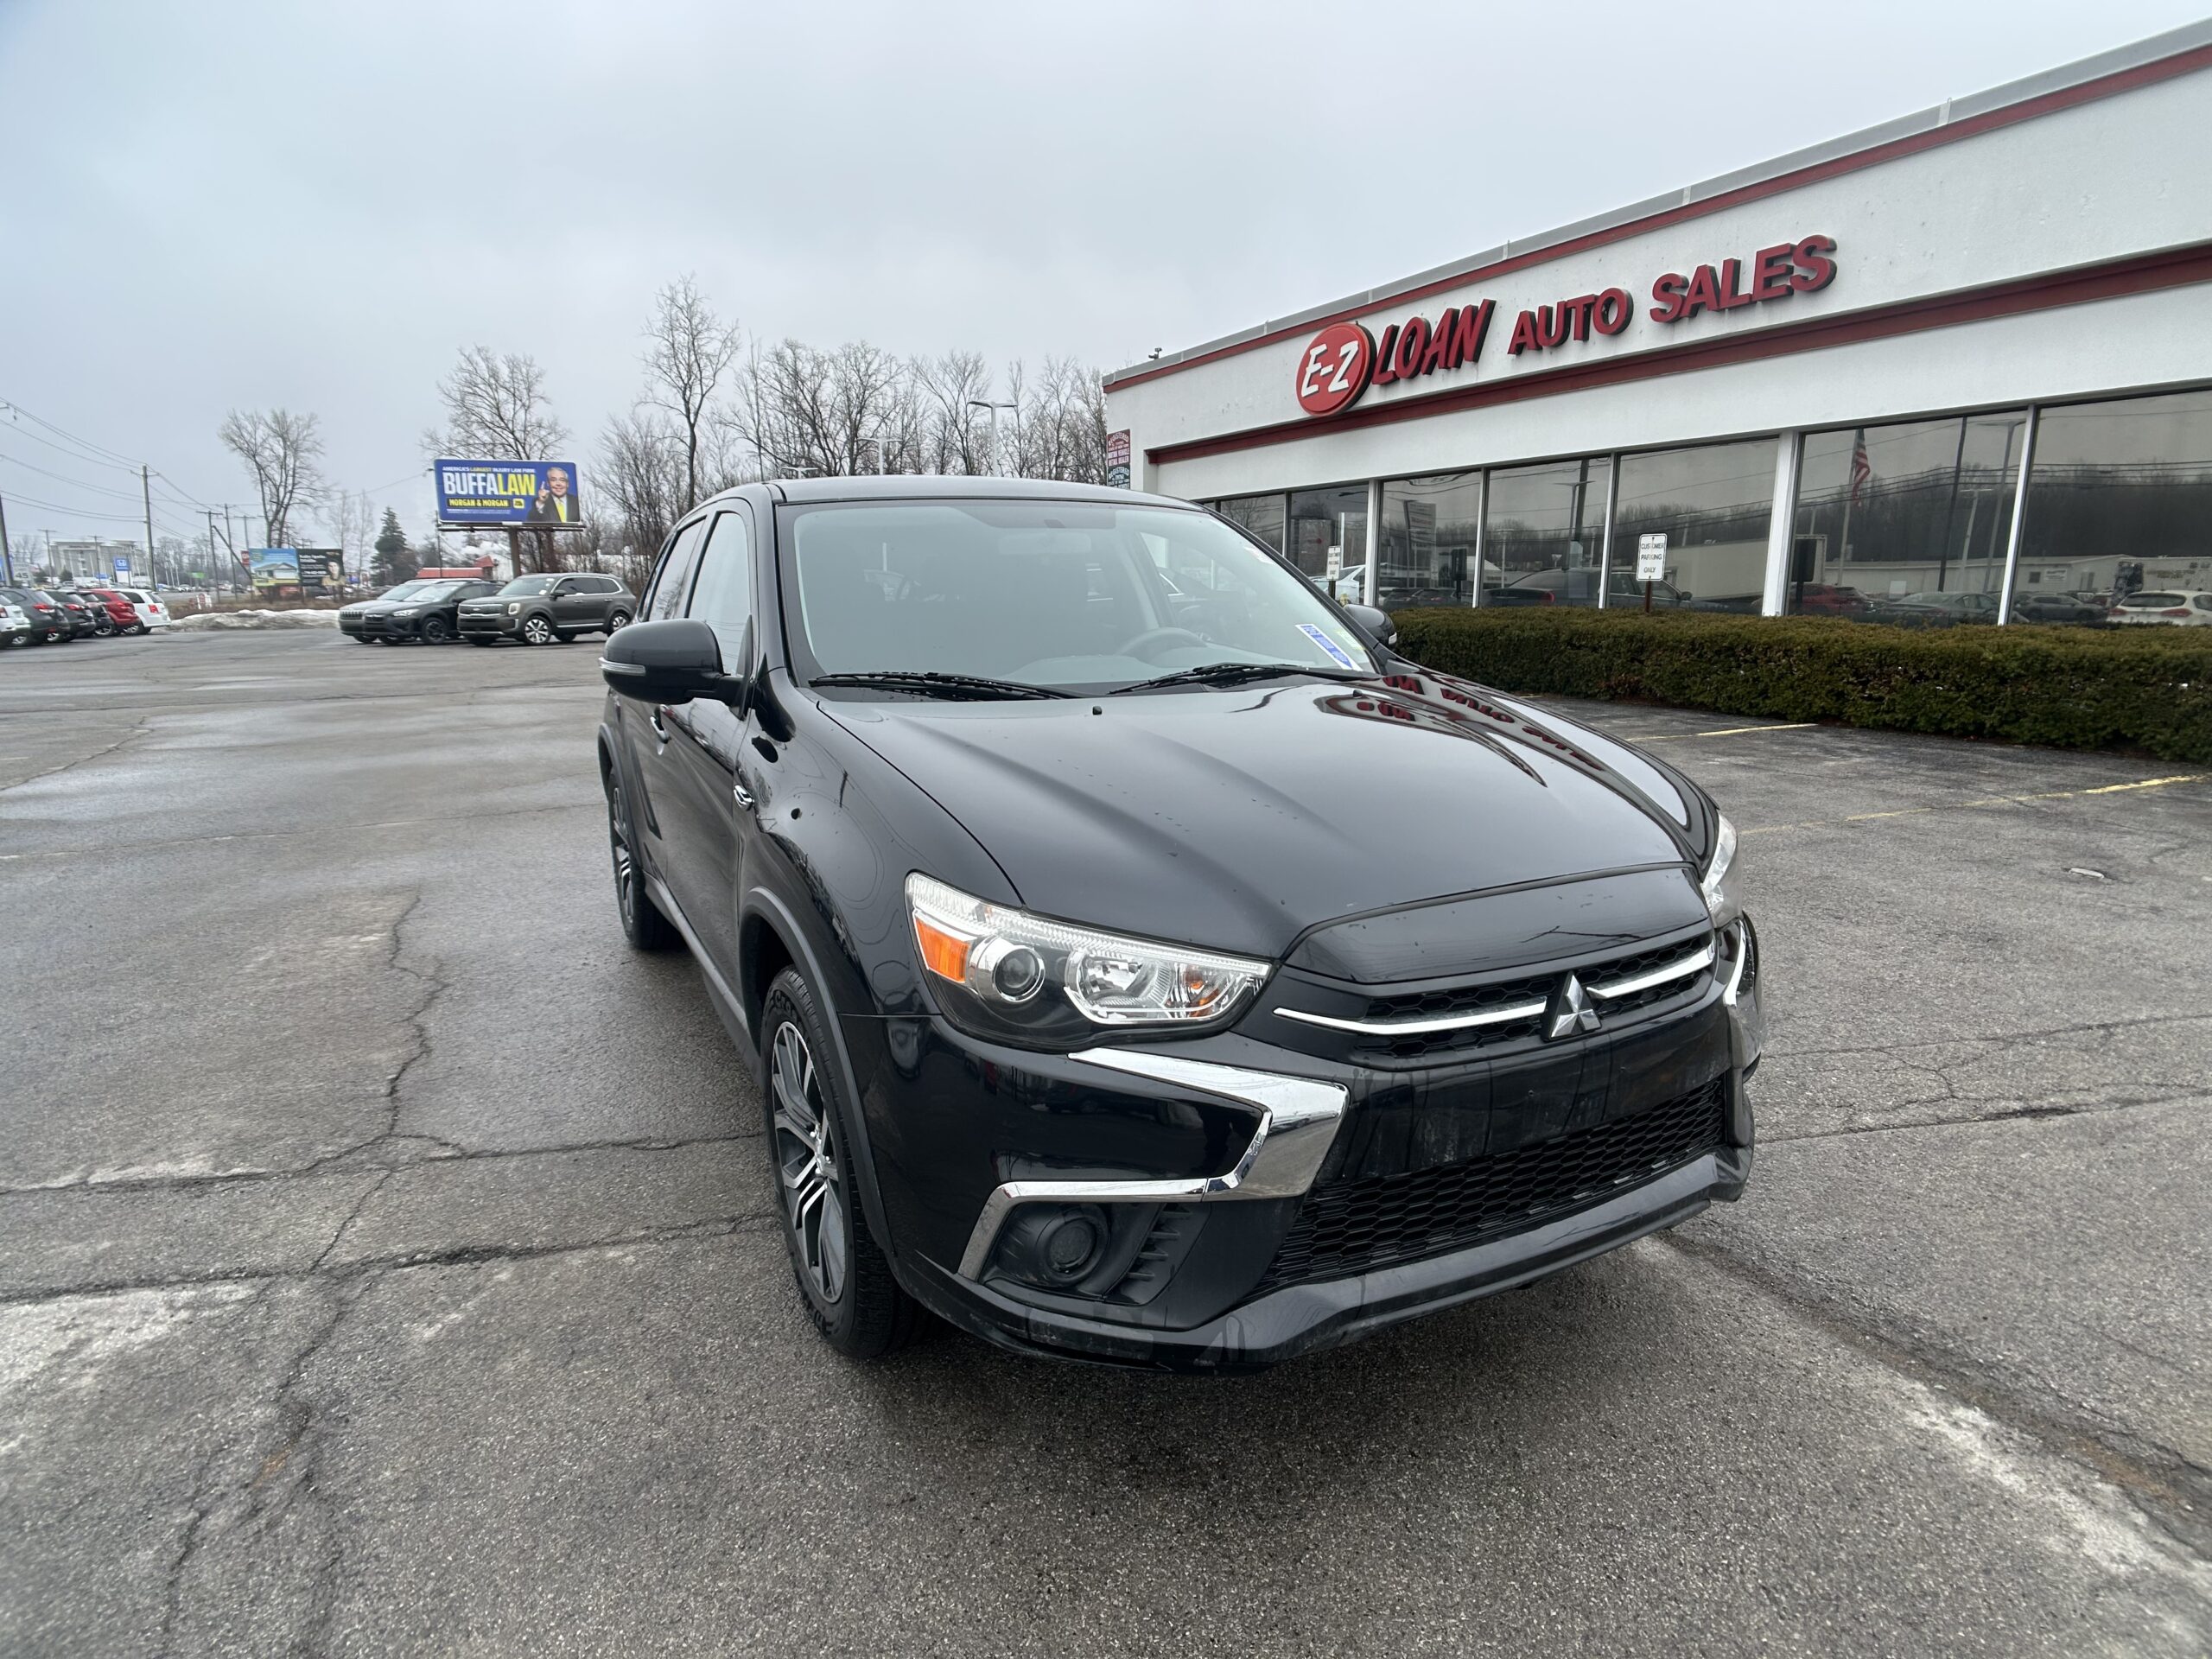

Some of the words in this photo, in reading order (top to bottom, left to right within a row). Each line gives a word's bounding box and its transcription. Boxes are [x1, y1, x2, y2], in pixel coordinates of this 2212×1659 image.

[1301, 340, 1359, 397] E-Z
[1372, 298, 1497, 385] LOAN
[1507, 287, 1634, 355] AUTO
[1649, 234, 1838, 323] SALES
[442, 472, 536, 495] BUFFALAW
